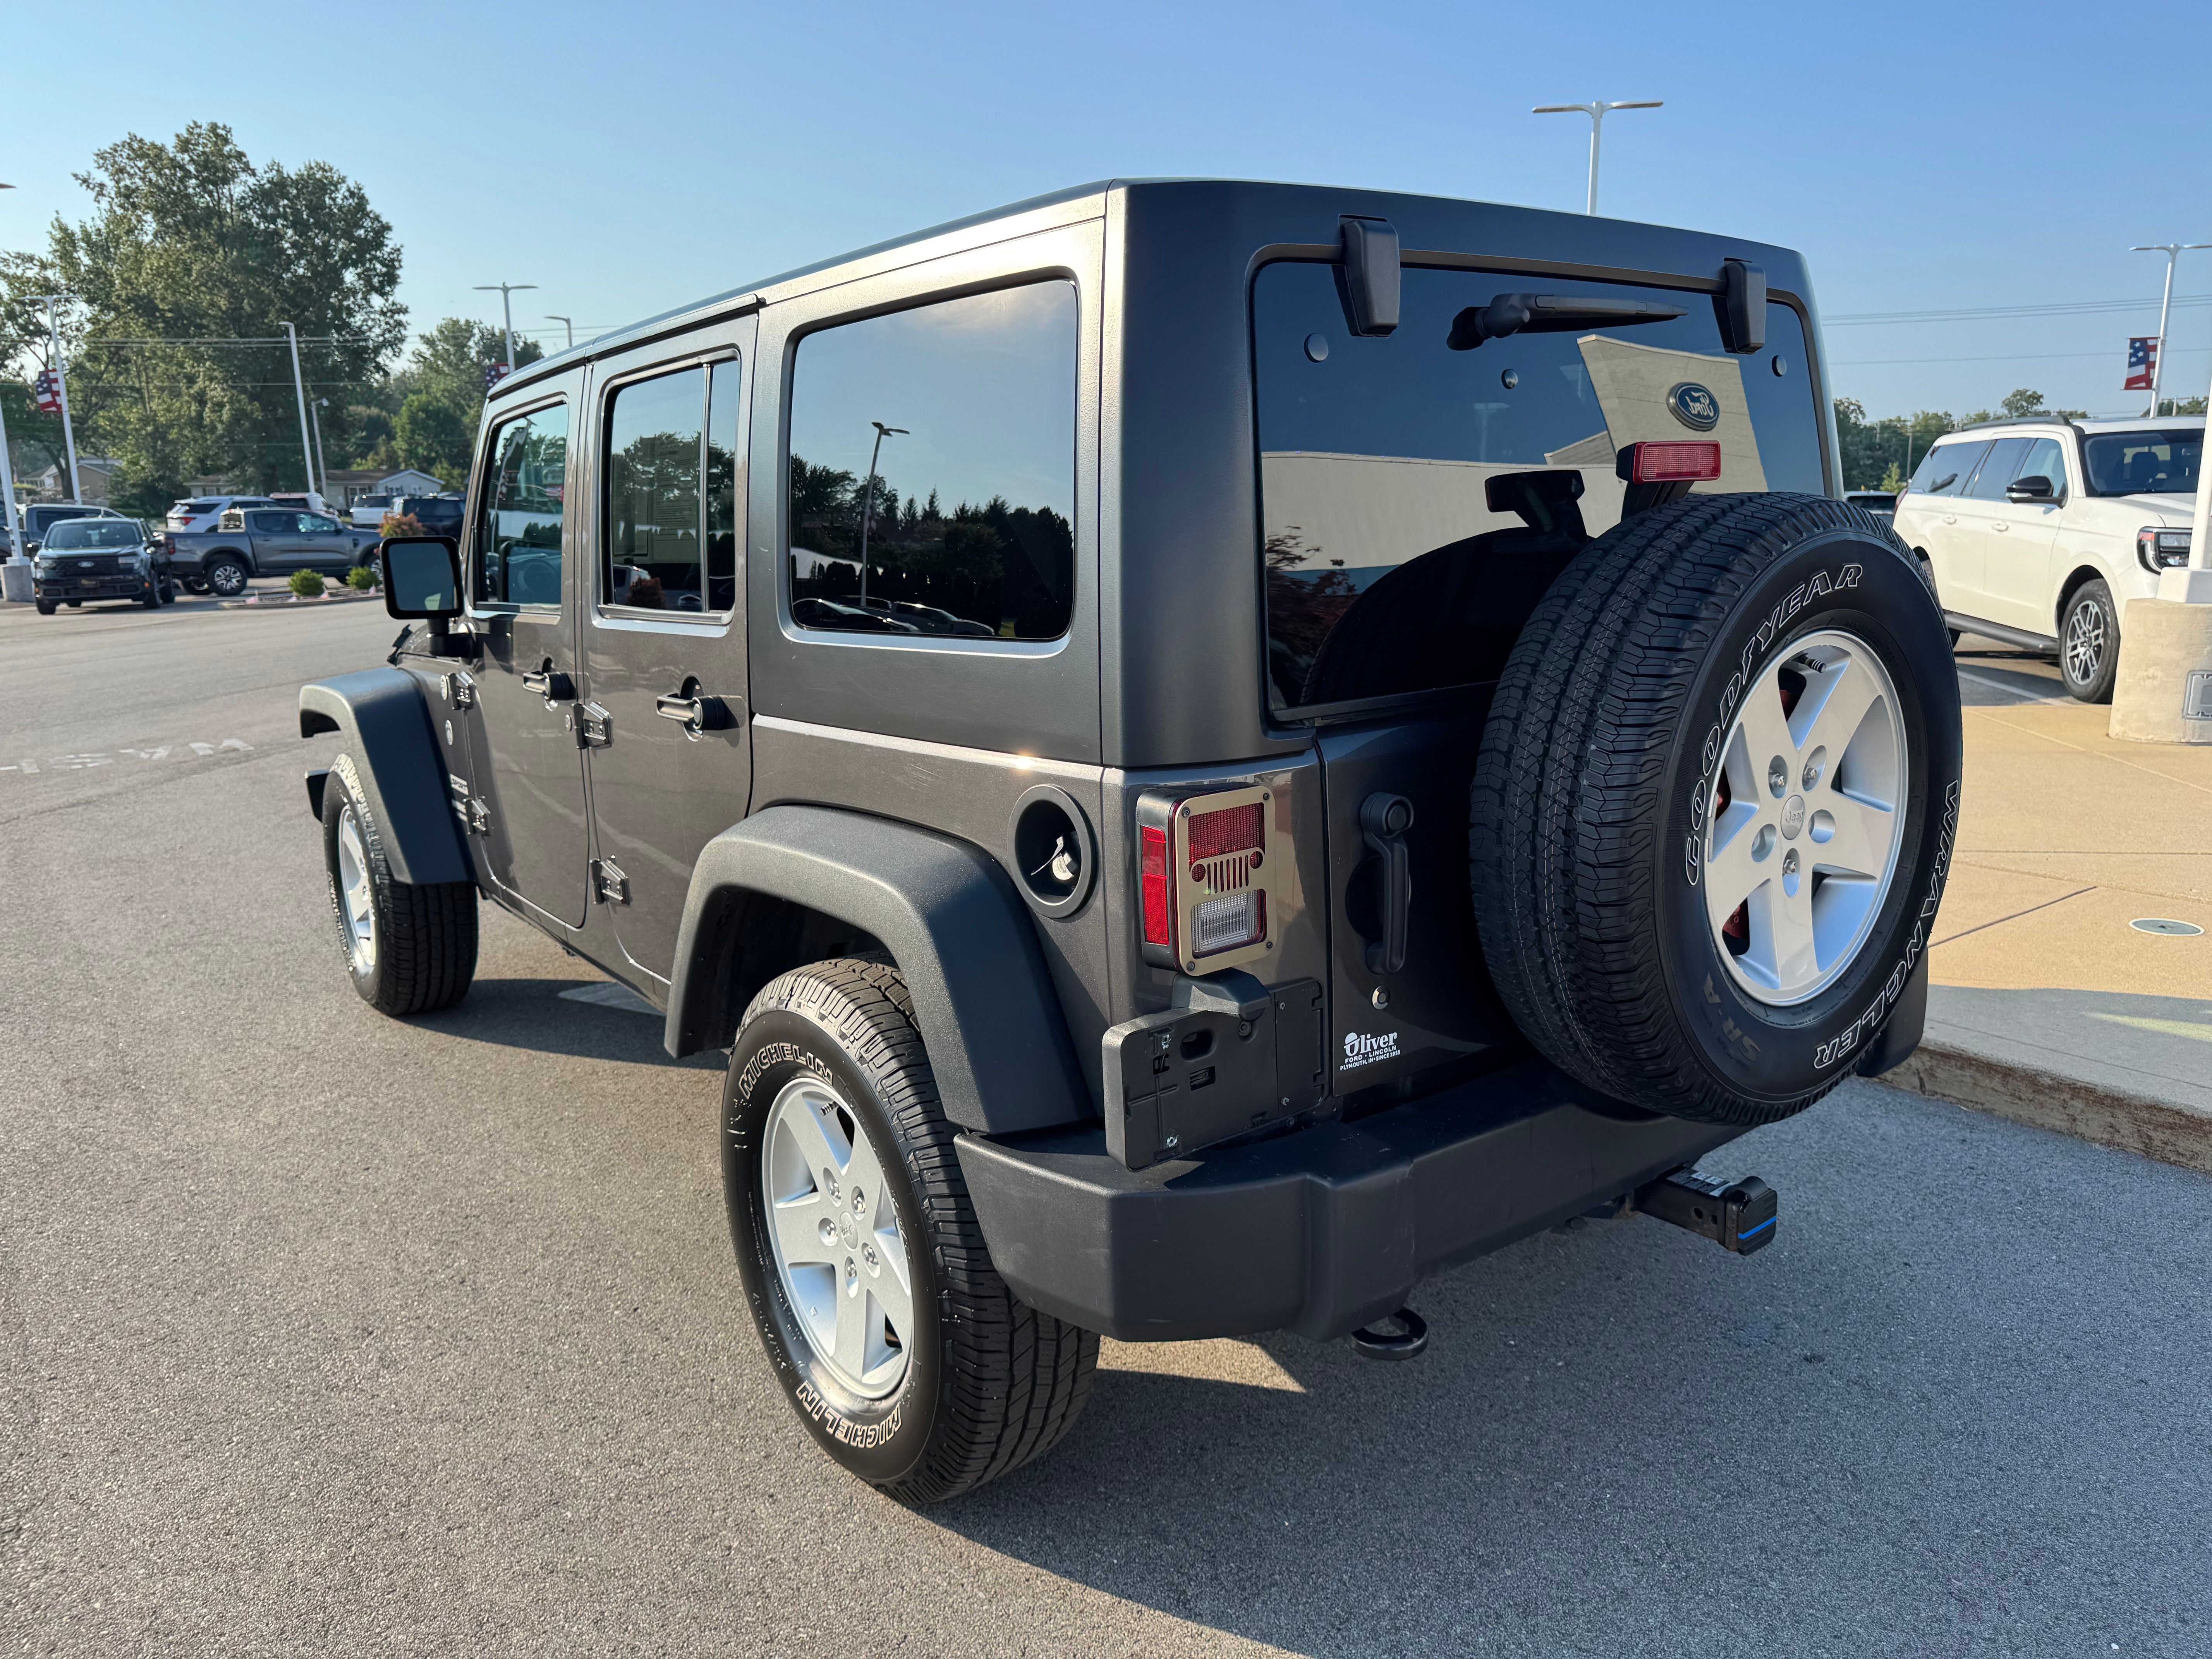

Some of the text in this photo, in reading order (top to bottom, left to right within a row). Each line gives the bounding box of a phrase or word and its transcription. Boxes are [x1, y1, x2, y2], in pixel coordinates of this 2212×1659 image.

[1686, 564, 1862, 886] GOODYEAR
[1785, 811, 1804, 824] Jeep
[1814, 780, 1958, 1070] WRANGLER
[738, 1042, 833, 1100] MICHELIN
[1344, 1032, 1397, 1056] Oliver
[1345, 1045, 1396, 1064] FORD LINCOLN
[795, 1380, 902, 1448] MICHELIN
